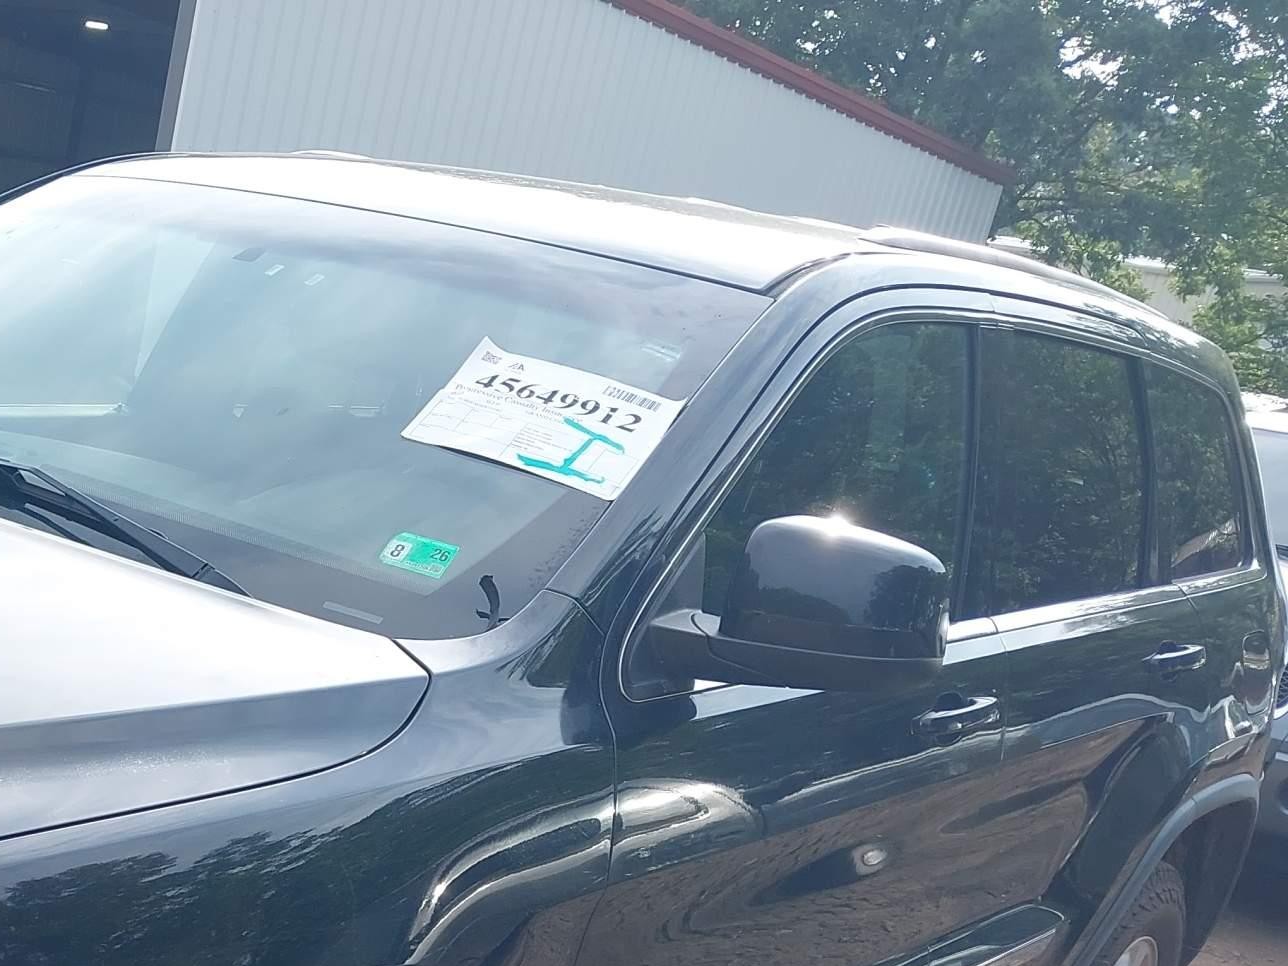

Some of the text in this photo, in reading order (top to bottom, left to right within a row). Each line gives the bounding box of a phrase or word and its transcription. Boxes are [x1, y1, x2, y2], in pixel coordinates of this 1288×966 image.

[475, 374, 642, 433] 45649912
[390, 544, 451, 562] 8 26
